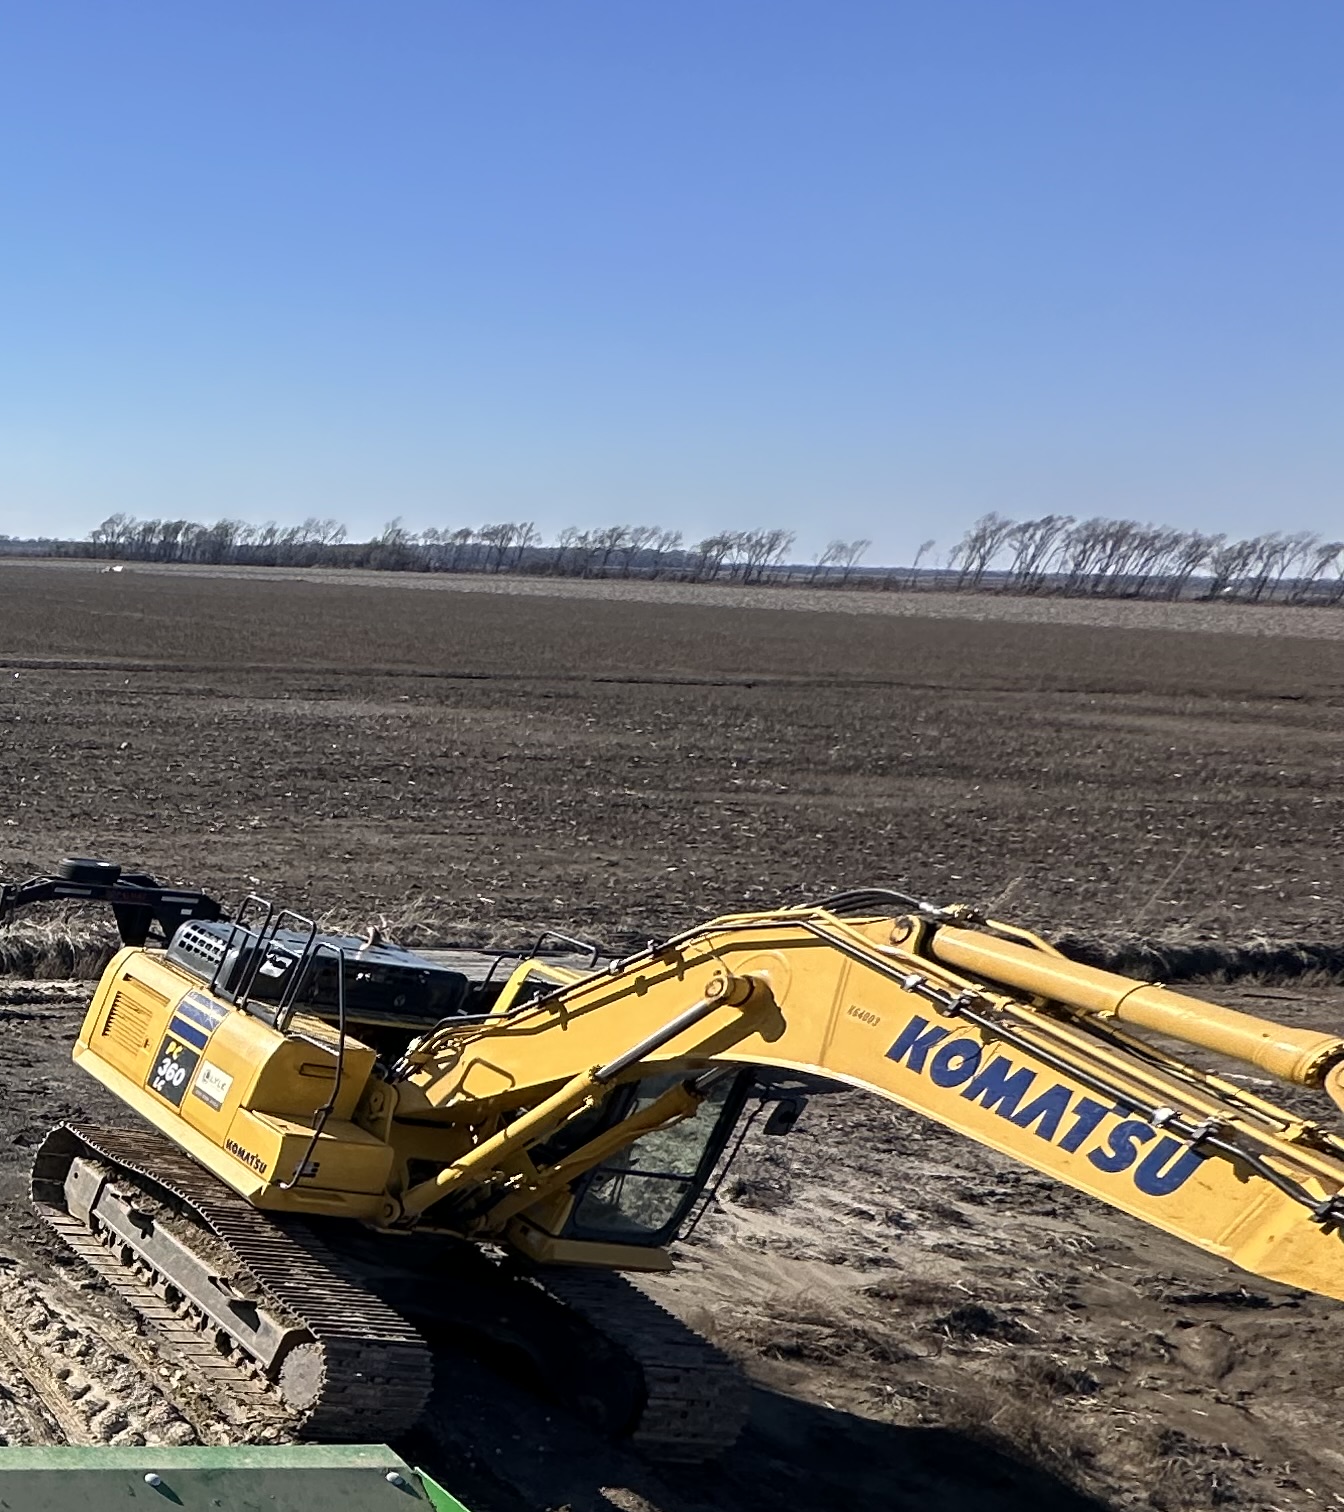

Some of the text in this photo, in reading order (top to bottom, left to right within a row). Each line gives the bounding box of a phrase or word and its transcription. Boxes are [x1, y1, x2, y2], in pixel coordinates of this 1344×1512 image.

[165, 1040, 184, 1061] PC
[157, 1057, 186, 1087] 360
[884, 1014, 1205, 1197] KOMATSU
[225, 1138, 268, 1175] KOMATSU
